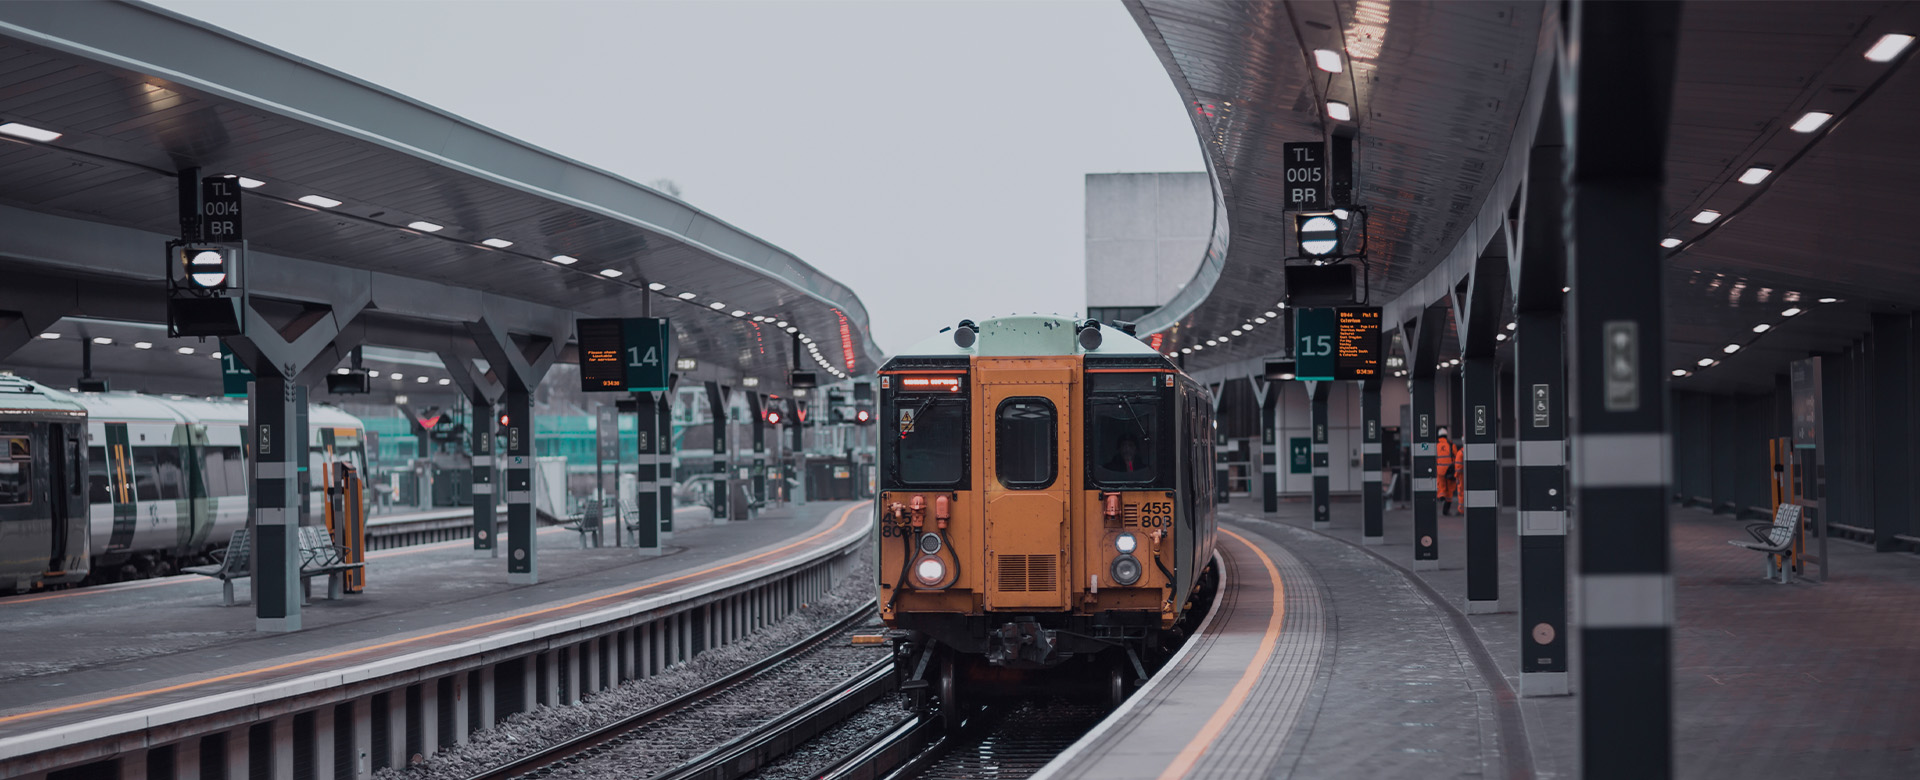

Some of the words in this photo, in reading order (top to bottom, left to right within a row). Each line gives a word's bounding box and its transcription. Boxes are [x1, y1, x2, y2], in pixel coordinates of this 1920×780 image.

[1293, 148, 1315, 162] TL
[1287, 167, 1322, 183] 0015
[212, 182, 232, 196] TL
[1292, 188, 1317, 202] BR
[205, 201, 239, 216] 0014
[211, 221, 234, 235] BR
[1301, 335, 1332, 356] 15
[223, 353, 251, 374] 1
[627, 346, 659, 367] 14
[1141, 502, 1171, 515] 455
